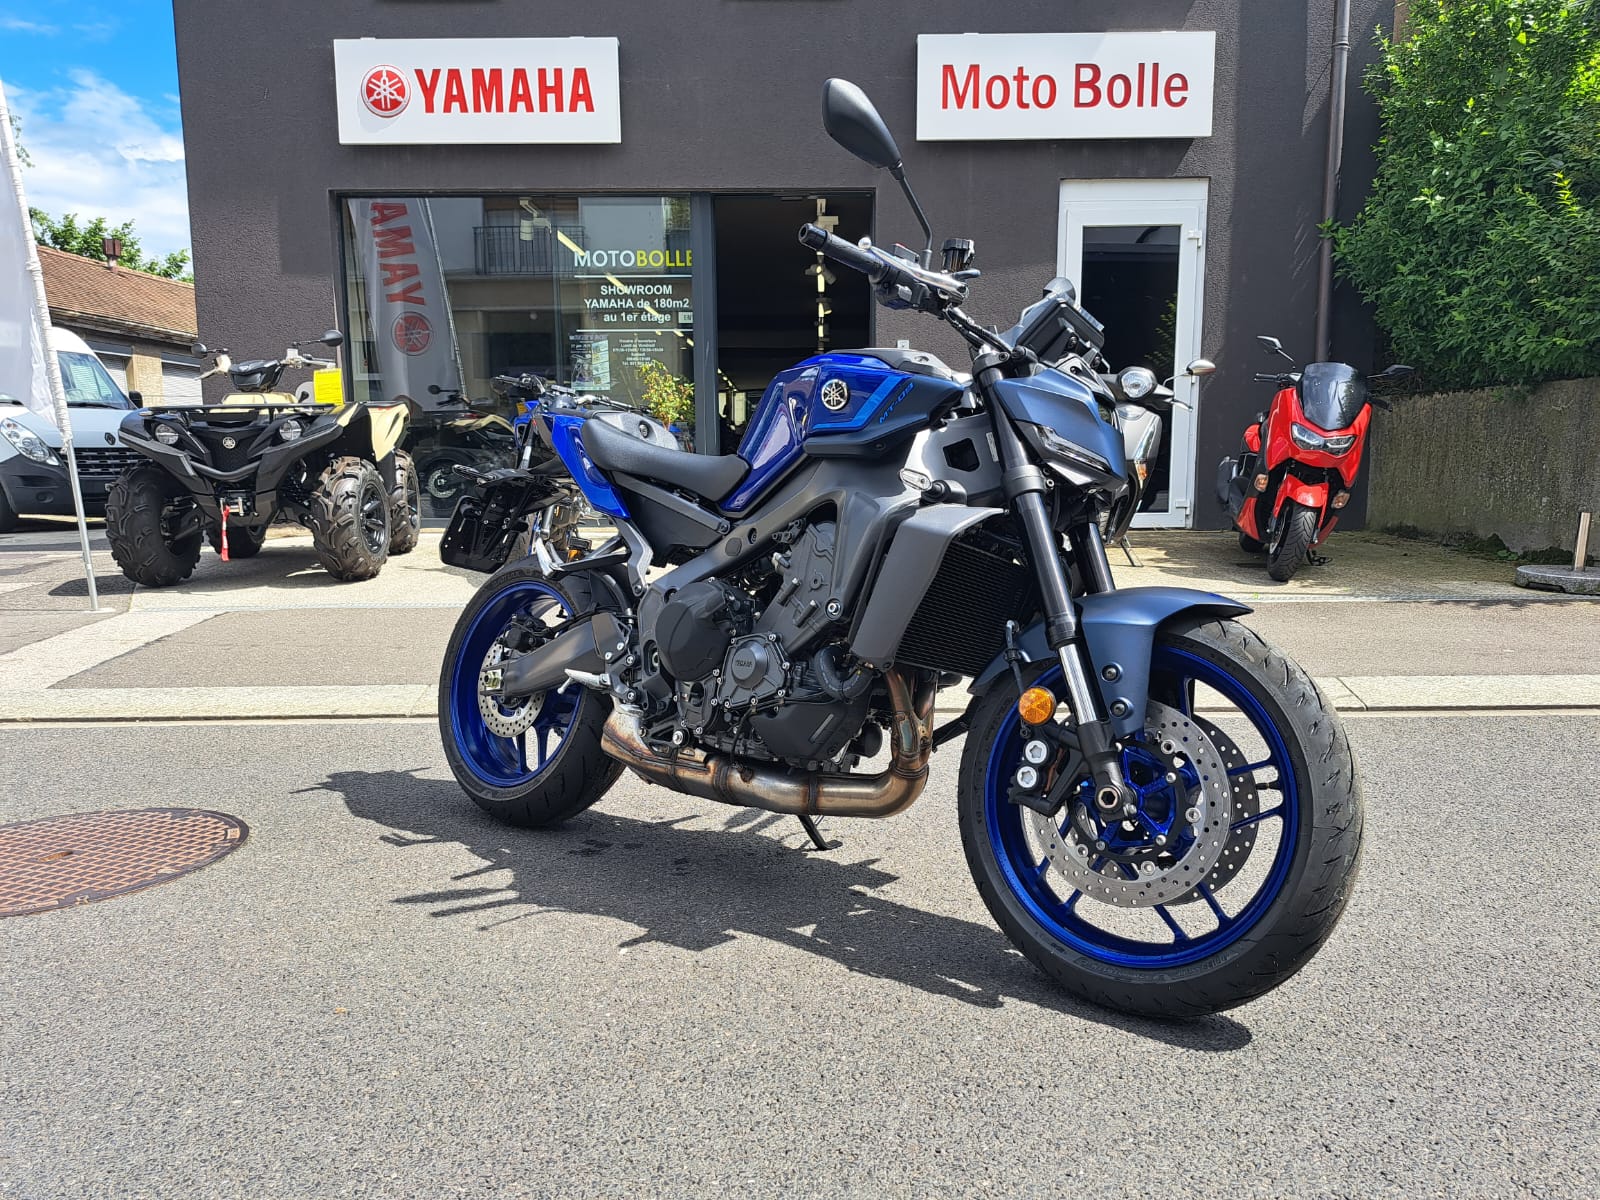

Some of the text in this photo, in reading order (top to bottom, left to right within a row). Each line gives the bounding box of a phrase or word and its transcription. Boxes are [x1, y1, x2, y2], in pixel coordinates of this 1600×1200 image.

[414, 67, 595, 113] YAMAHA
[941, 62, 1189, 110] Moto Bolle
[574, 249, 693, 267] MOTOBOLLE
[600, 284, 673, 295] SHOWROOM
[584, 298, 690, 308] YAMAHA de 180m2
[603, 312, 671, 324] au 1er étage
[879, 382, 914, 424] MT-09
